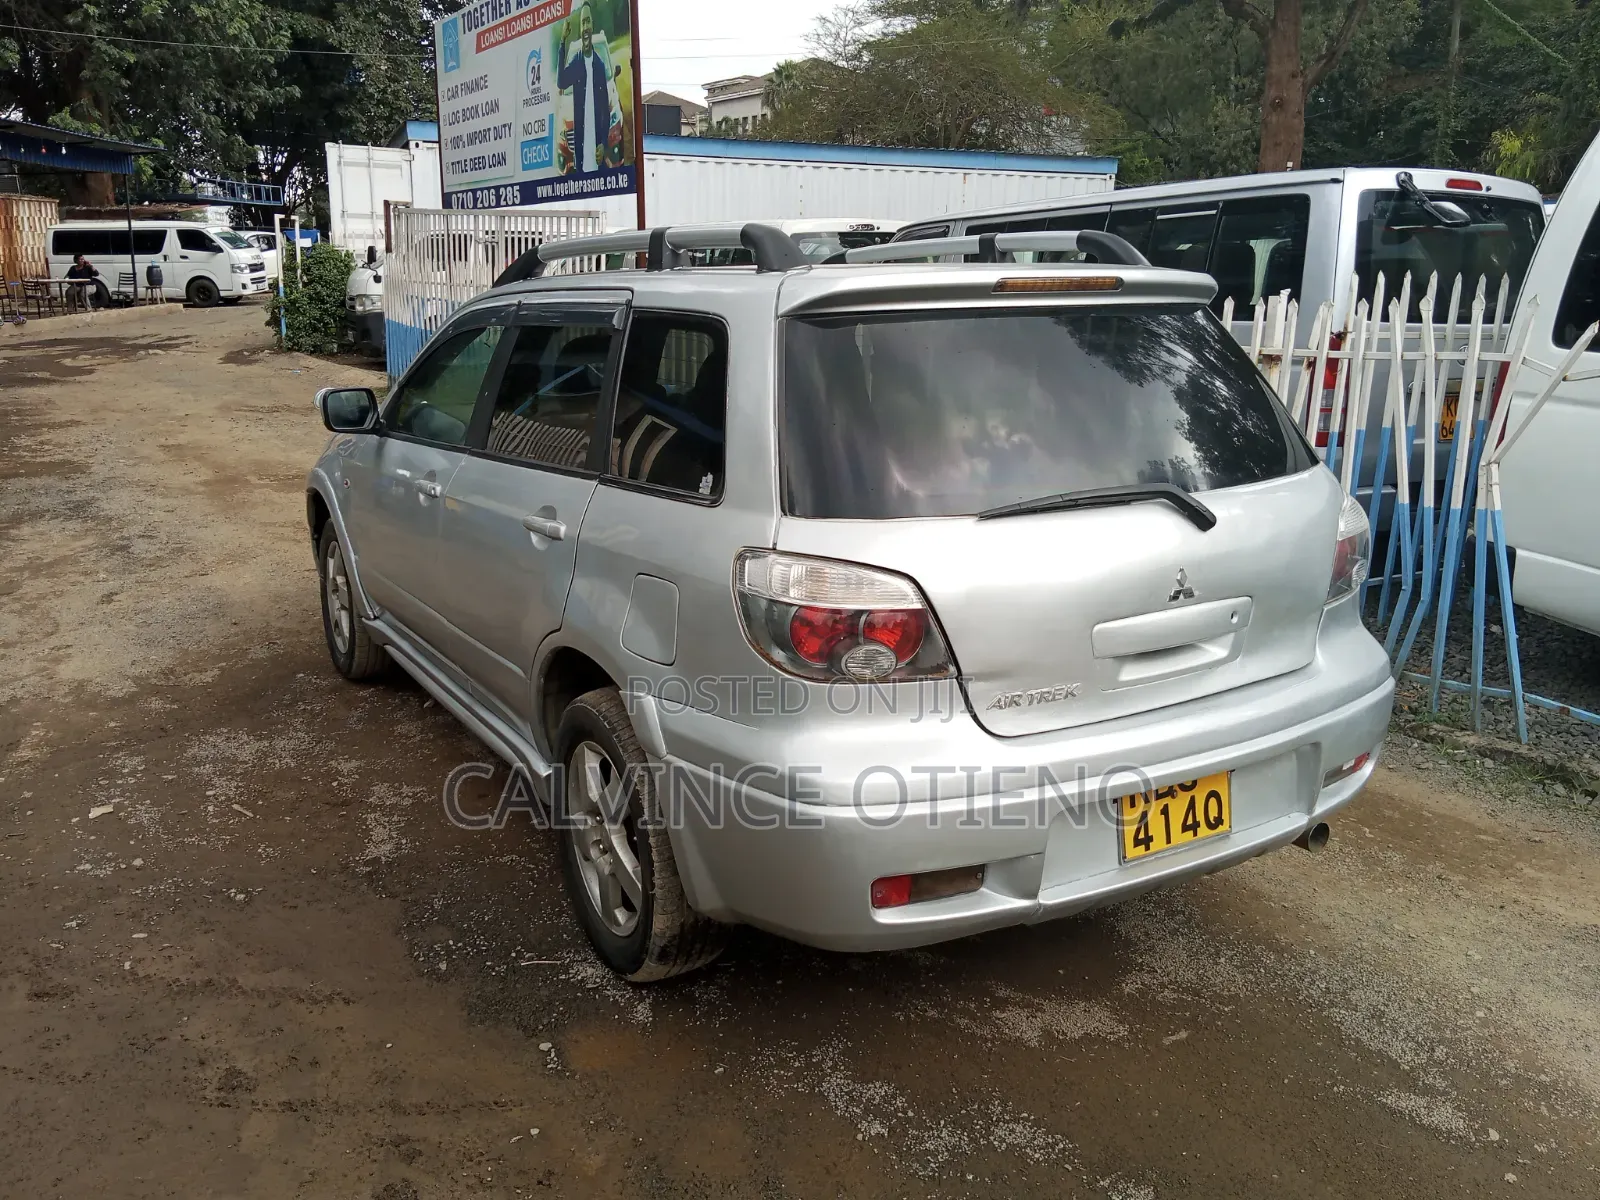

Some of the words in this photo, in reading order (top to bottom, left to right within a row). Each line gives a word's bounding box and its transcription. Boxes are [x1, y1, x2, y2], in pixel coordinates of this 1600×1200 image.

[461, 0, 511, 34] TOGETHER
[480, 25, 505, 48] LOANS!
[506, 15, 534, 37] LOANS!
[535, 2, 565, 26] LOANS!
[447, 84, 459, 101] CAR
[460, 74, 489, 97] FINANCE
[531, 64, 541, 86] 24
[522, 92, 551, 108] PROCESSING
[531, 86, 542, 95] HOURS
[447, 110, 460, 126] LOG
[462, 104, 481, 122] BOOK
[481, 98, 500, 117] LOAN
[450, 134, 466, 150] 100%
[466, 126, 492, 147] IMPORT
[493, 122, 513, 141] DUTY
[522, 122, 533, 136] NO
[533, 119, 546, 134] CRB
[451, 158, 469, 175] TITLE
[469, 155, 487, 172] DEED
[488, 151, 507, 169] LOAN
[522, 143, 550, 165] CHECKS
[451, 191, 474, 210] 0710
[476, 189, 497, 208] 206
[499, 185, 521, 205] 285
[536, 172, 628, 199] www.togetherasone.co.ke
[1133, 790, 1225, 851] 414Q
